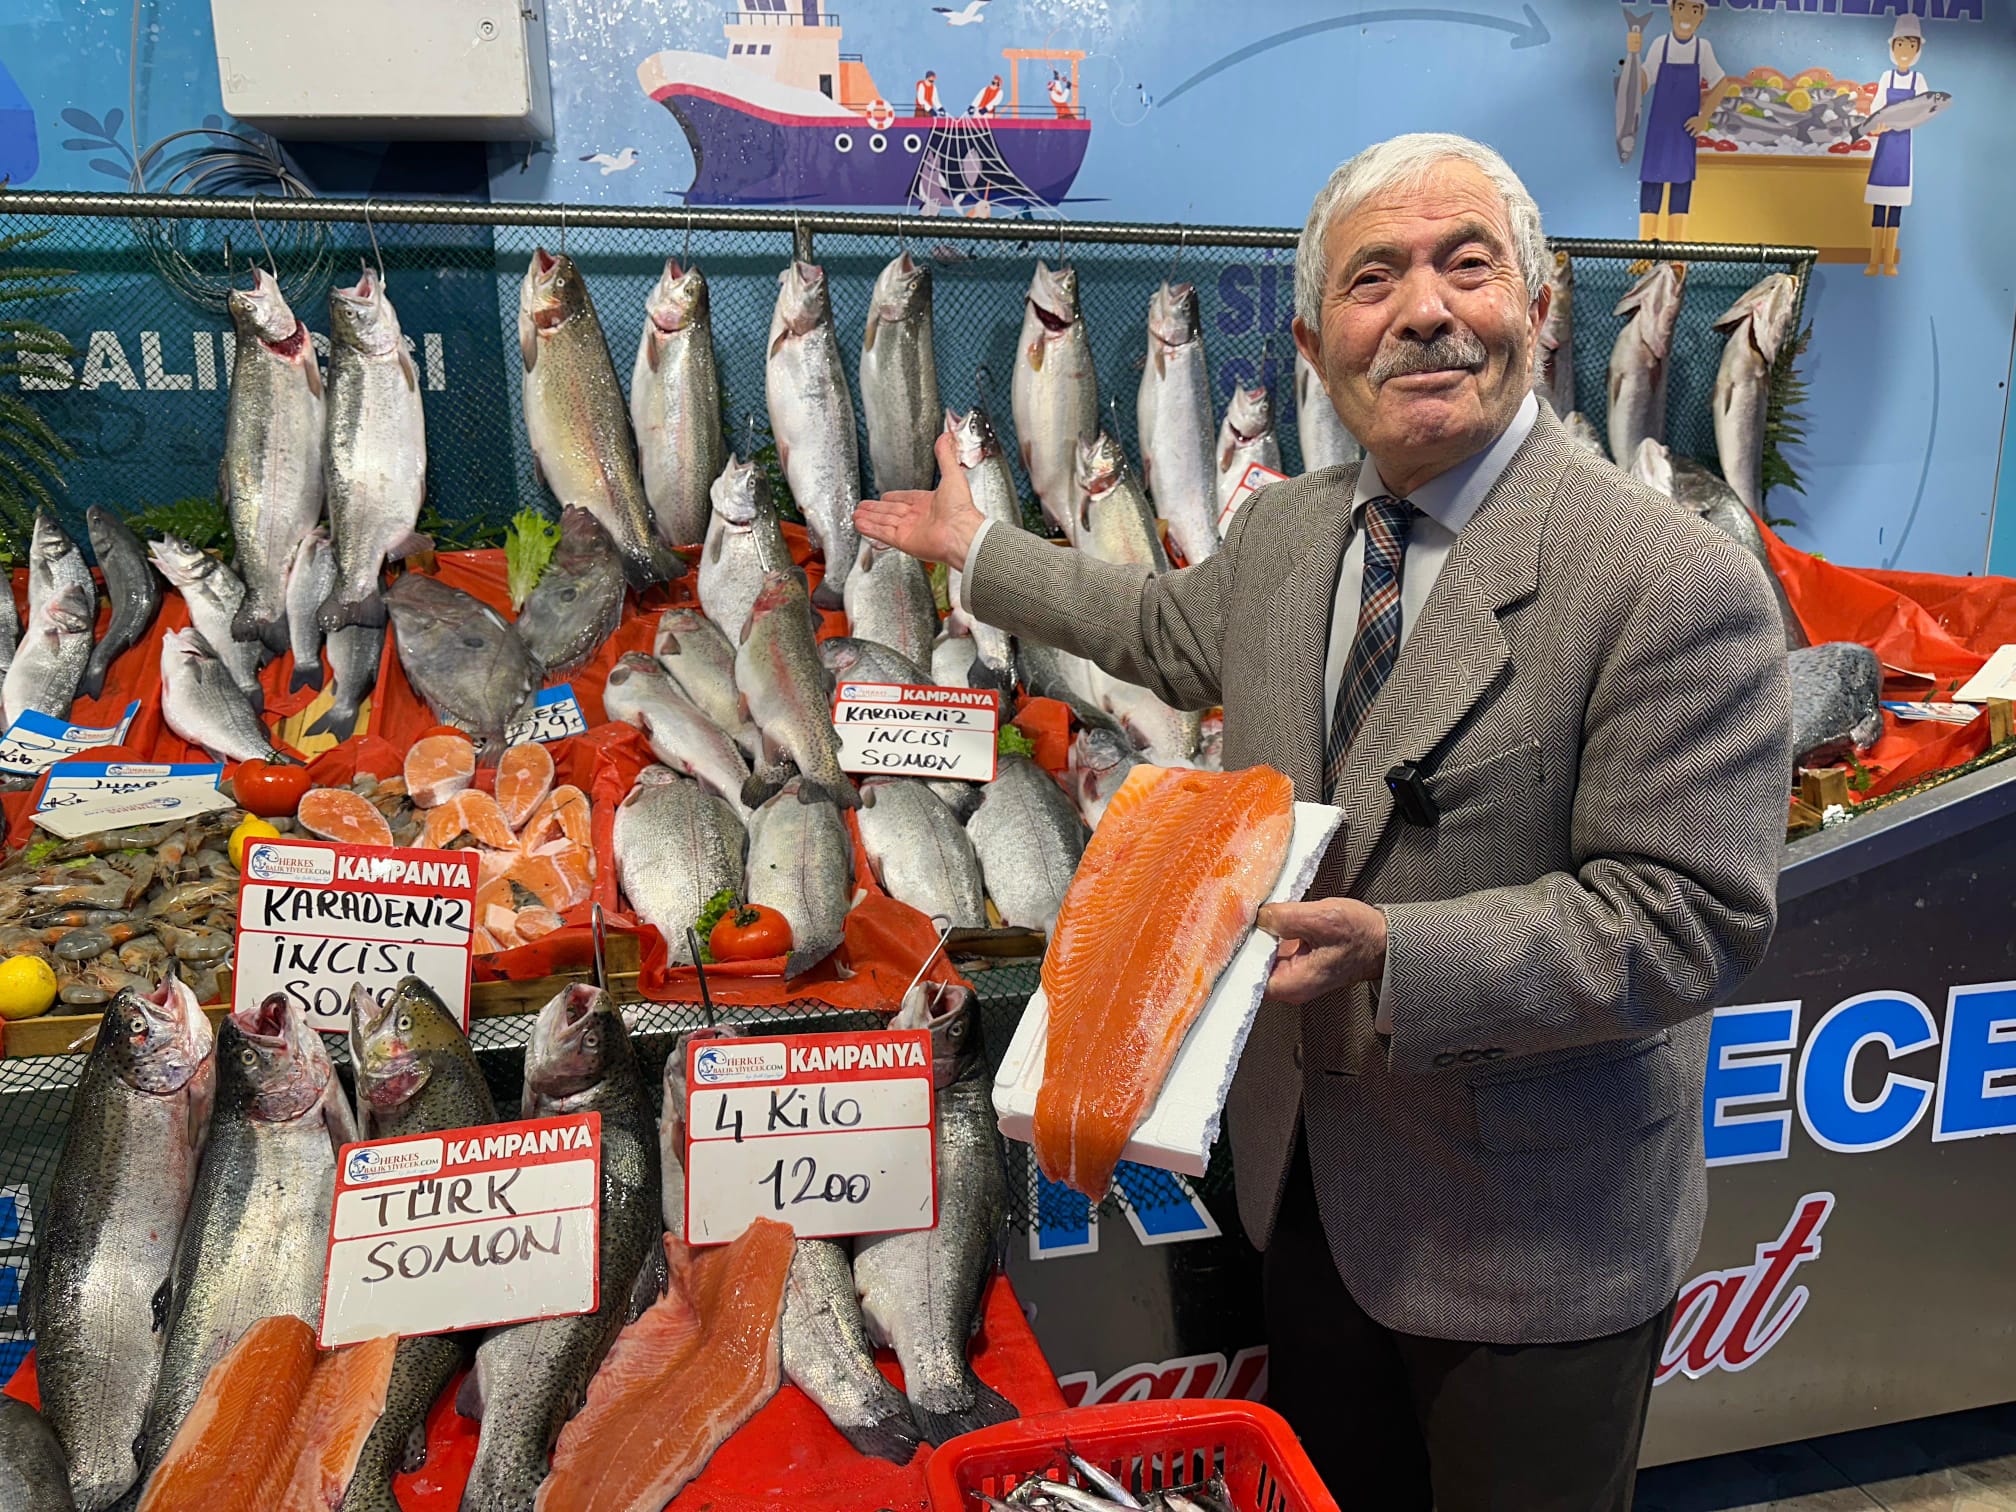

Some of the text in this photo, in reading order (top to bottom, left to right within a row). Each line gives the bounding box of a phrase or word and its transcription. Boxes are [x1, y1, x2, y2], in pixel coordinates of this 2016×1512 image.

[15, 331, 446, 390] BALII
[904, 689, 995, 706] KAMPANYA
[861, 749, 961, 771] SOMON
[280, 857, 314, 868] HERKES
[337, 856, 471, 889] KAMPANYA
[726, 1056, 765, 1067] HERKES
[790, 1042, 926, 1073] KAMPANYA
[715, 1087, 861, 1142] 4 Kilo
[379, 1153, 420, 1165] HERKES
[446, 1125, 592, 1165] KAMPANYA
[361, 1168, 522, 1227] TÜRK
[758, 1156, 871, 1210] 1200
[361, 1216, 562, 1283] SOMON
